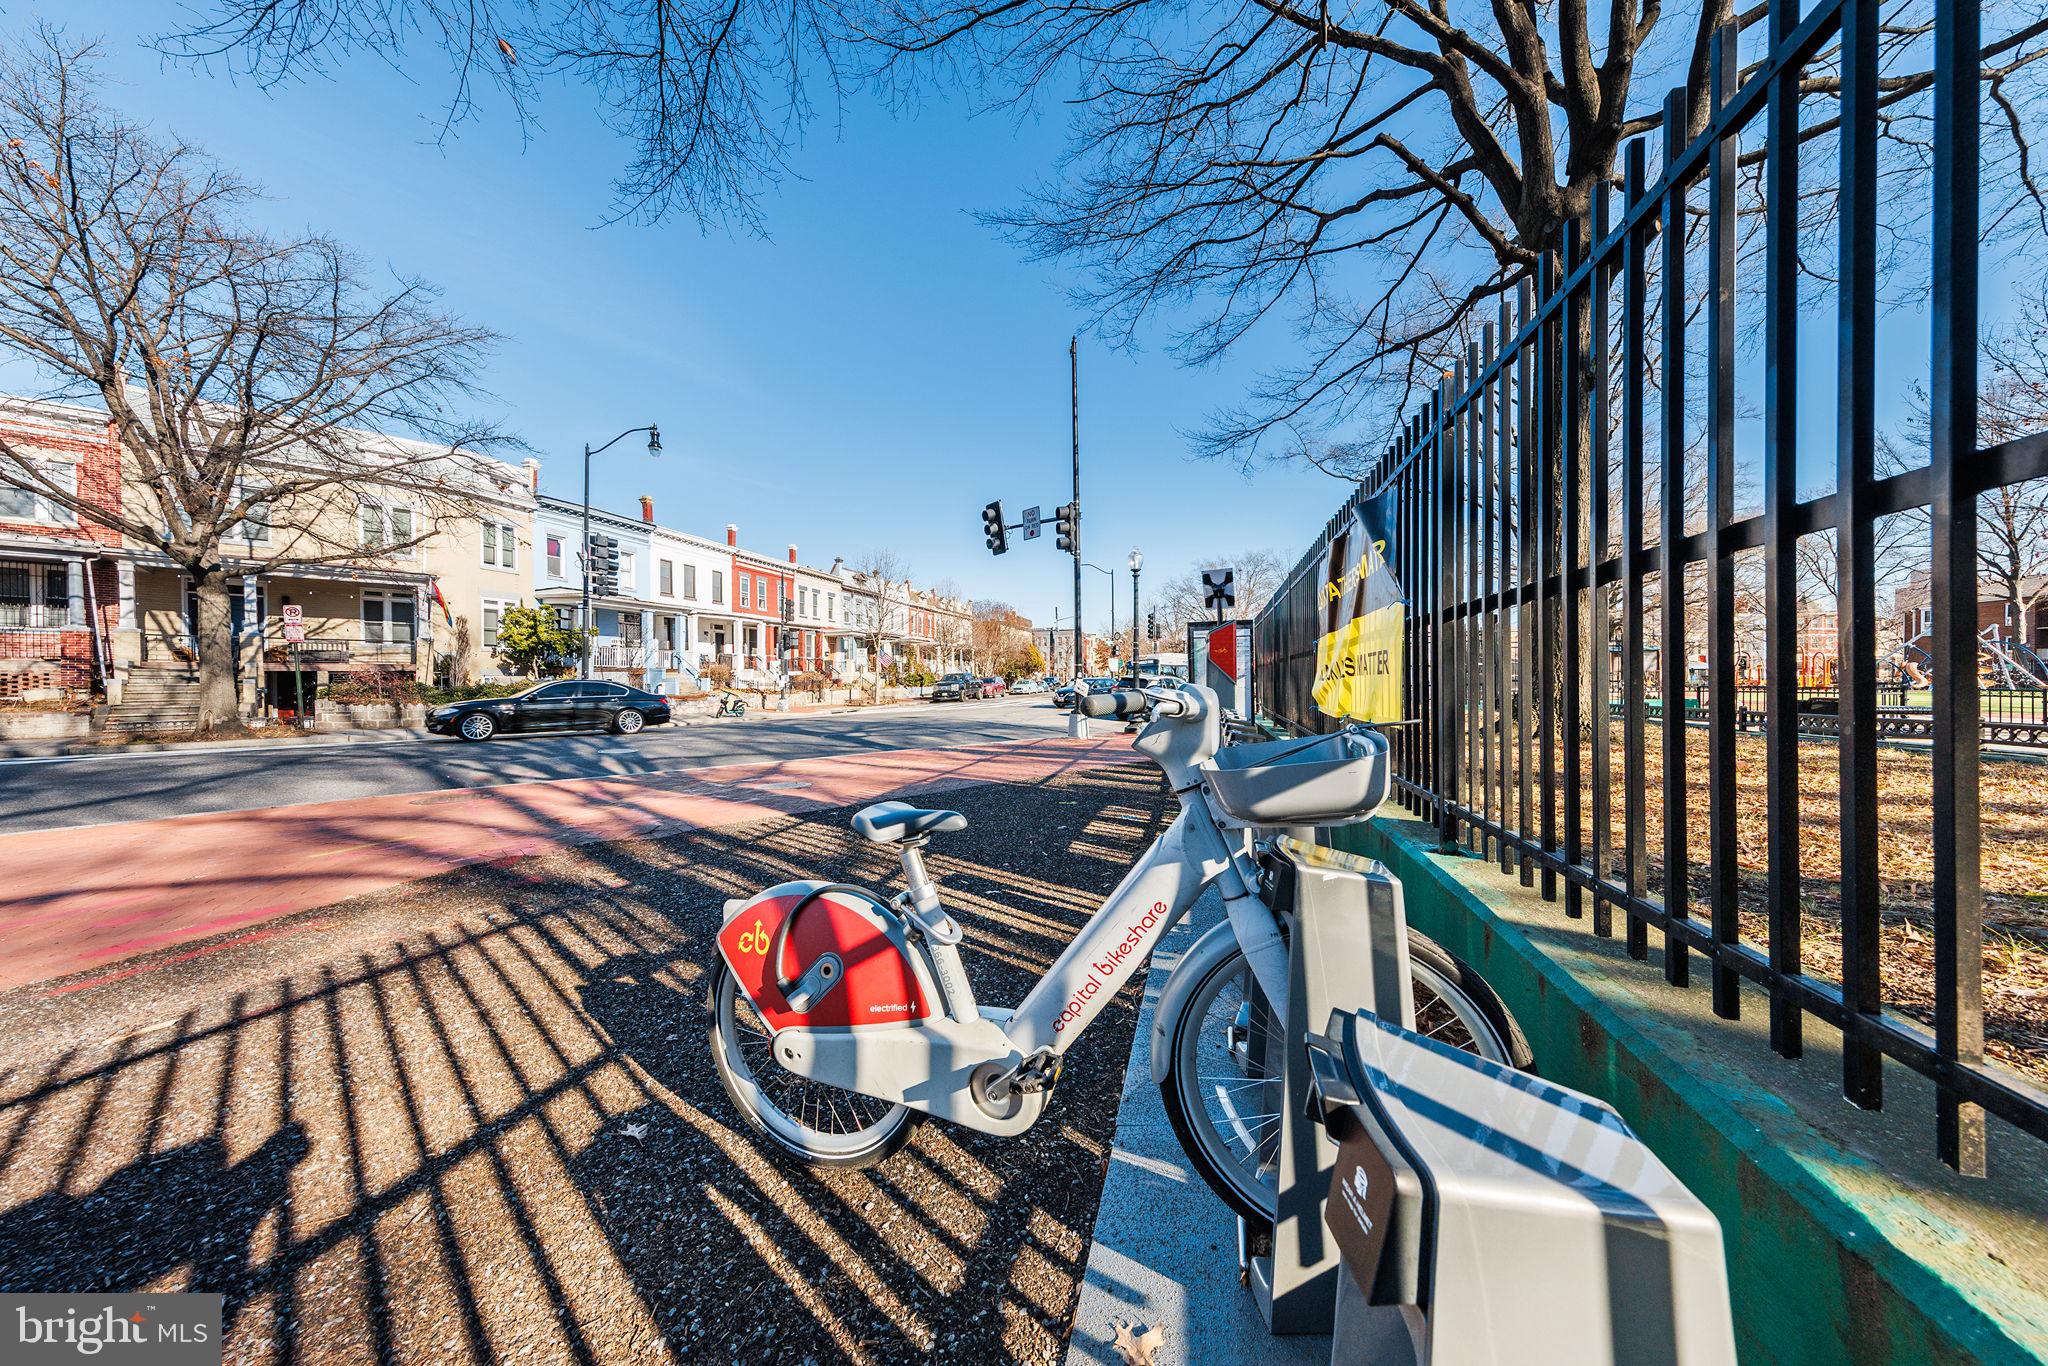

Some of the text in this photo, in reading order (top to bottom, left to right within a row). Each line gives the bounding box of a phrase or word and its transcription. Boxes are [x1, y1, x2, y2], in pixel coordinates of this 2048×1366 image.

[1027, 510, 1035, 518] NO
[1356, 649, 1390, 676] MATTER
[1053, 901, 1167, 1033] capital bikeshare
[869, 1003, 908, 1013] electrified
